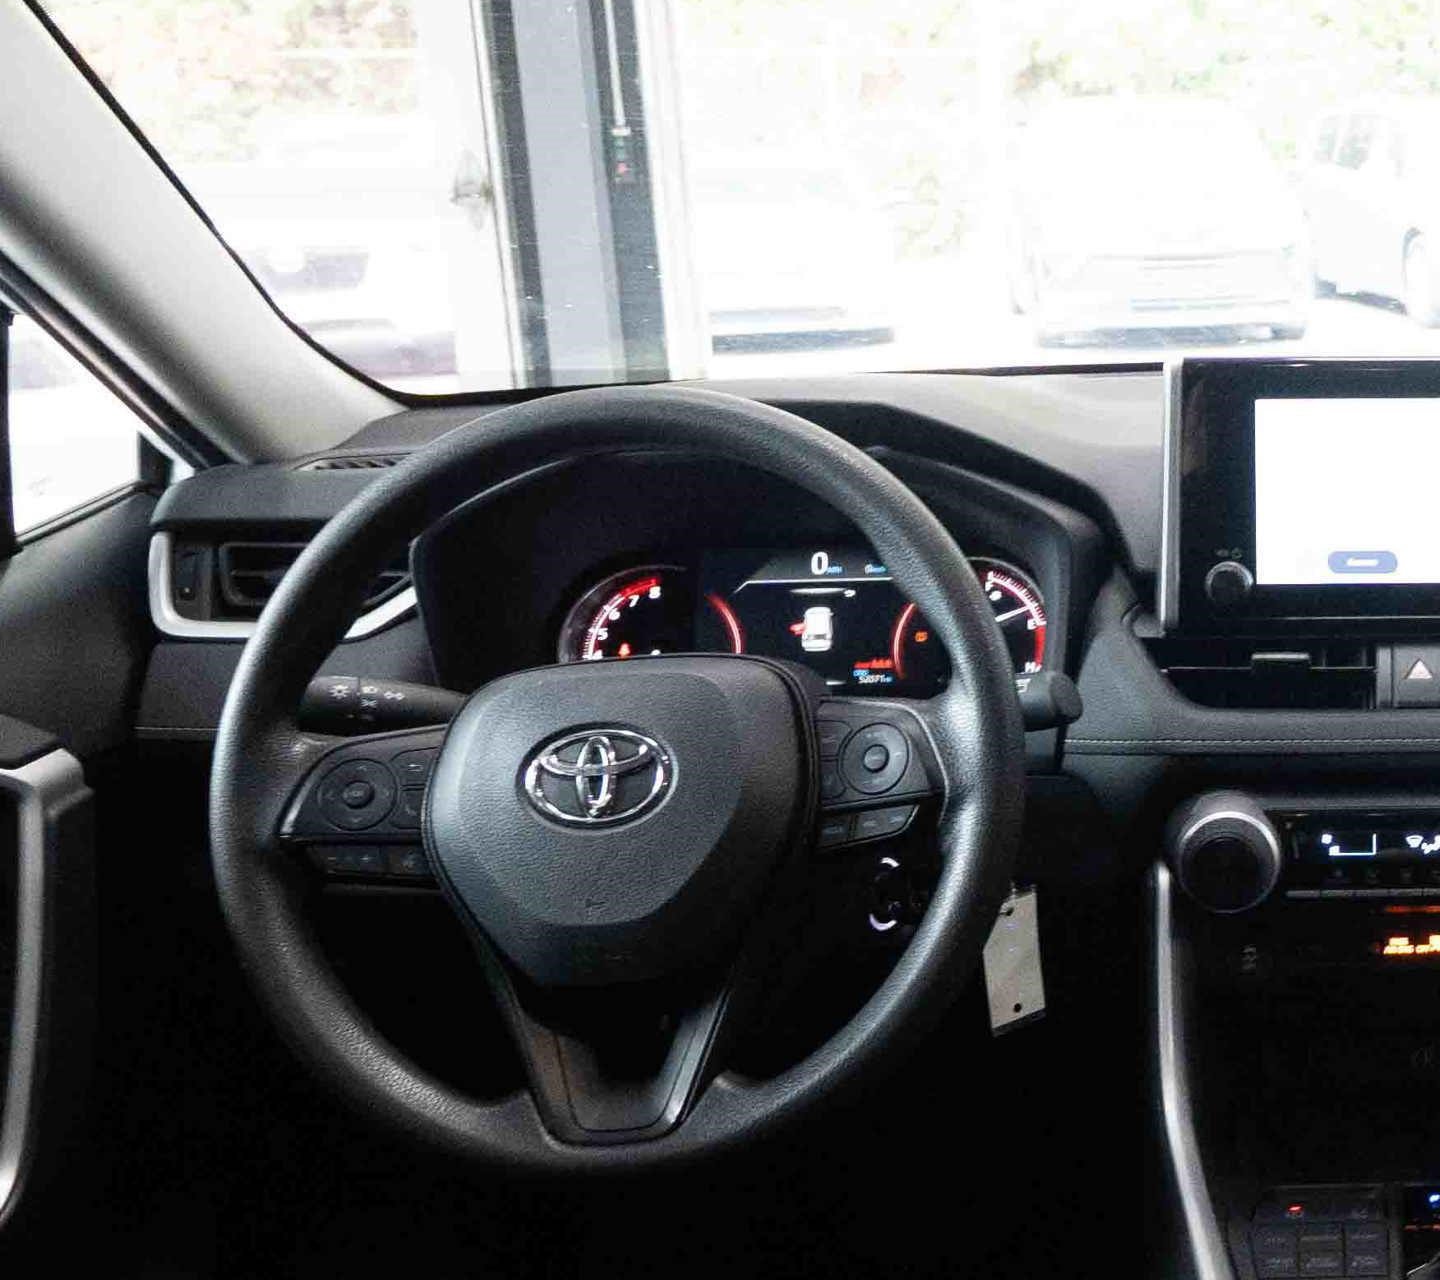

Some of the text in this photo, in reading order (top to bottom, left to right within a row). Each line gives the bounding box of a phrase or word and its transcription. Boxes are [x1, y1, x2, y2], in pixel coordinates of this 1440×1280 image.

[811, 550, 829, 575] 0
[648, 586, 661, 599] 8
[628, 595, 640, 608] 7
[608, 608, 621, 621] 6
[597, 628, 608, 641] 5
